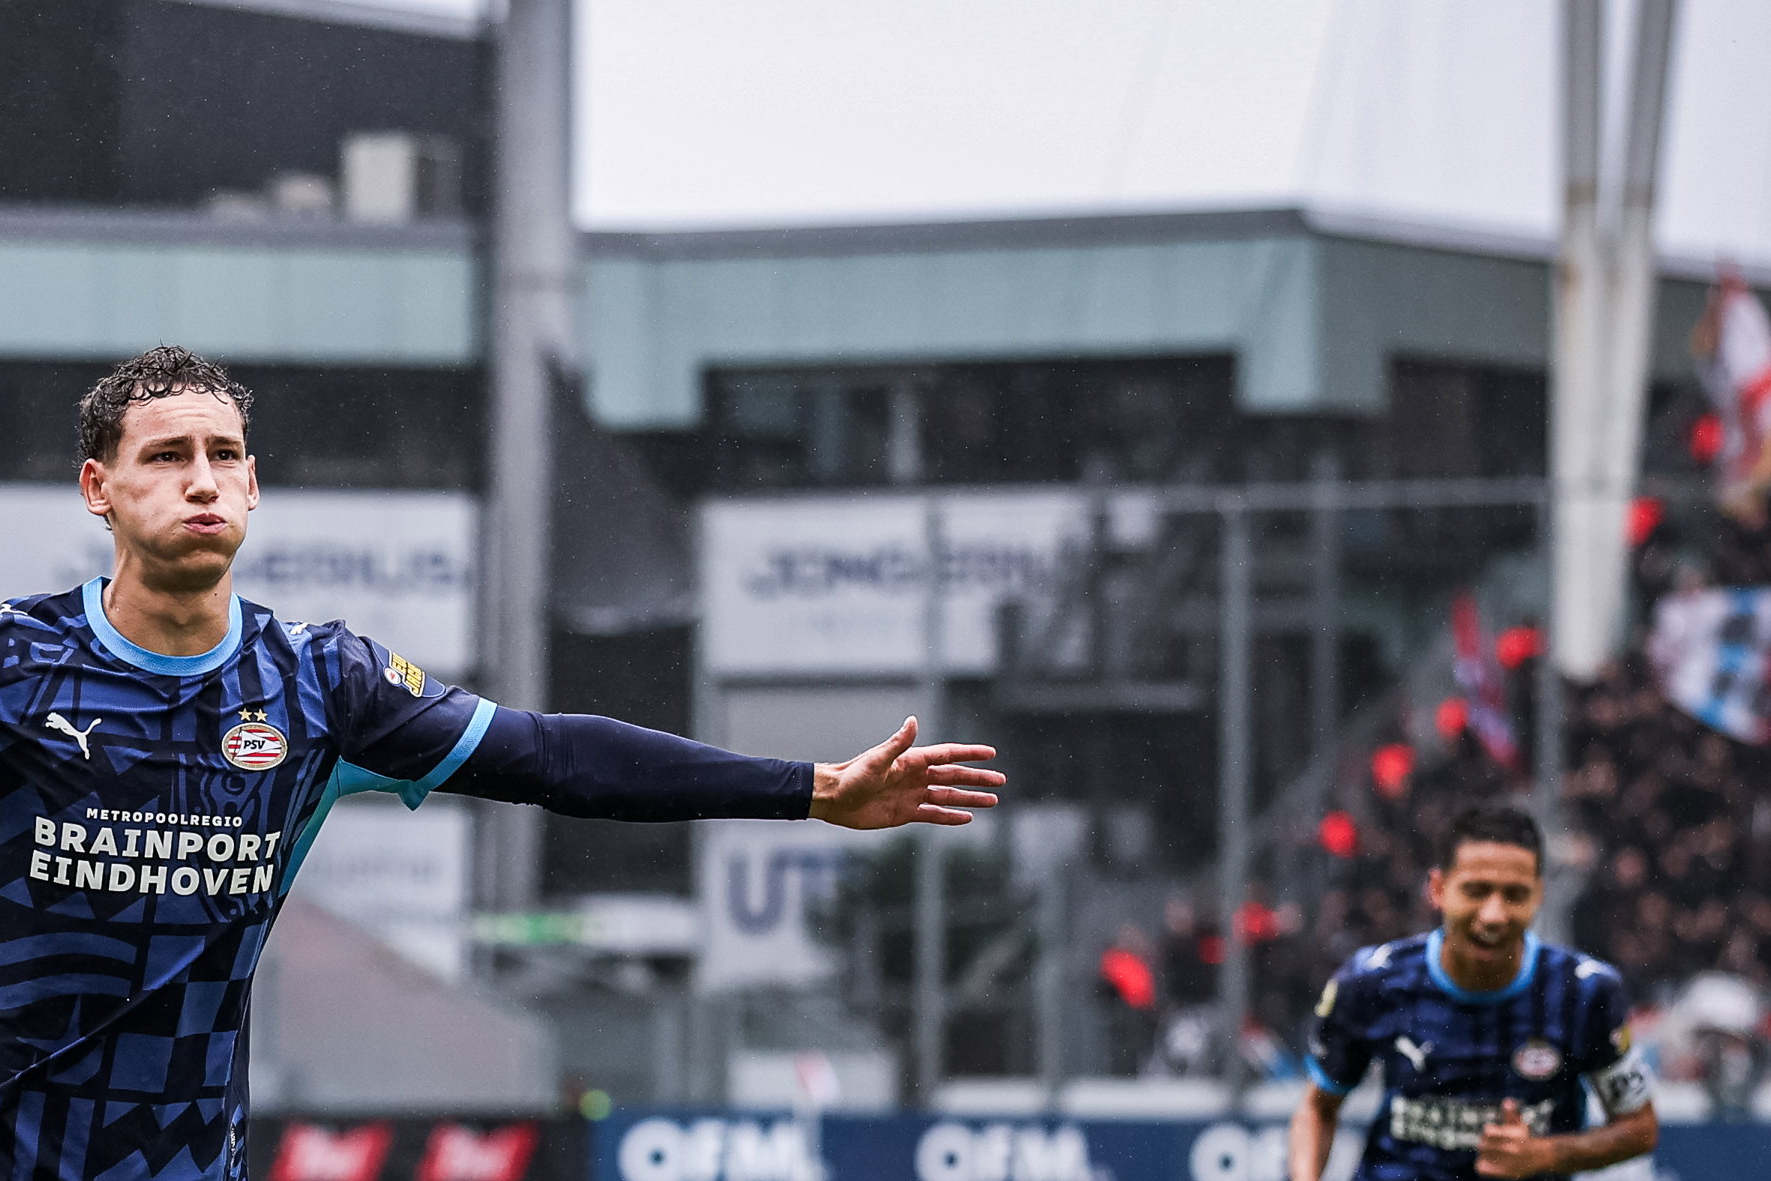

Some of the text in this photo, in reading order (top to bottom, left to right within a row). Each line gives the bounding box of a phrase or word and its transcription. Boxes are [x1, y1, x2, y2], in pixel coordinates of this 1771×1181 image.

[243, 740, 266, 750] PSV
[86, 808, 243, 828] METROPOOLREGIO
[34, 816, 281, 863] BRAINPORT
[29, 849, 274, 897] EINDHOVEN
